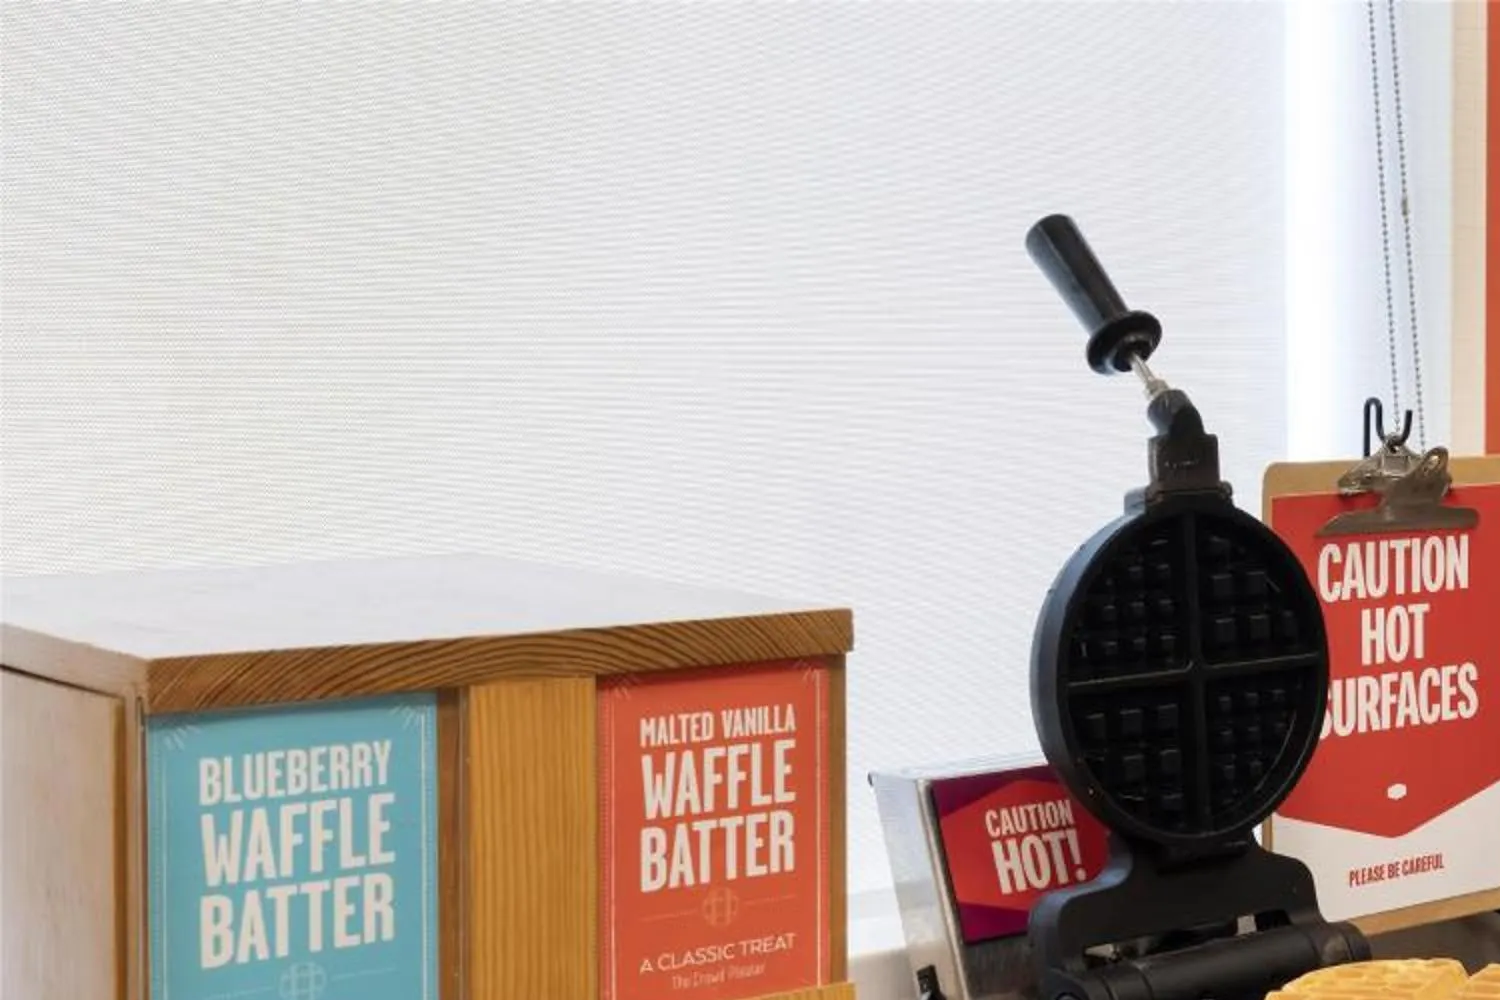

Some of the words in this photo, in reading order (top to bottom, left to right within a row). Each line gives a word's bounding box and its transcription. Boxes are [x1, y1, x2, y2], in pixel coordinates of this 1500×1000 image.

[1317, 534, 1469, 603] CAUTION
[1361, 603, 1430, 666] HOT
[640, 711, 714, 748] MALTED
[722, 703, 796, 739] VANILLA
[199, 740, 392, 807] BLUEBERRY
[641, 739, 796, 821] WAFFLE
[201, 792, 396, 887] WAFFLE
[640, 810, 795, 893] BATTER
[985, 799, 1075, 838] CAUTION
[991, 829, 1087, 895] HOT!
[1349, 867, 1387, 888] PLEASE
[1387, 861, 1400, 878] BE
[1401, 853, 1445, 876] CAREFUL
[201, 873, 395, 970] BATTER
[640, 958, 654, 974] A
[657, 943, 735, 971] CLASSIC
[738, 933, 796, 956] TREAT
